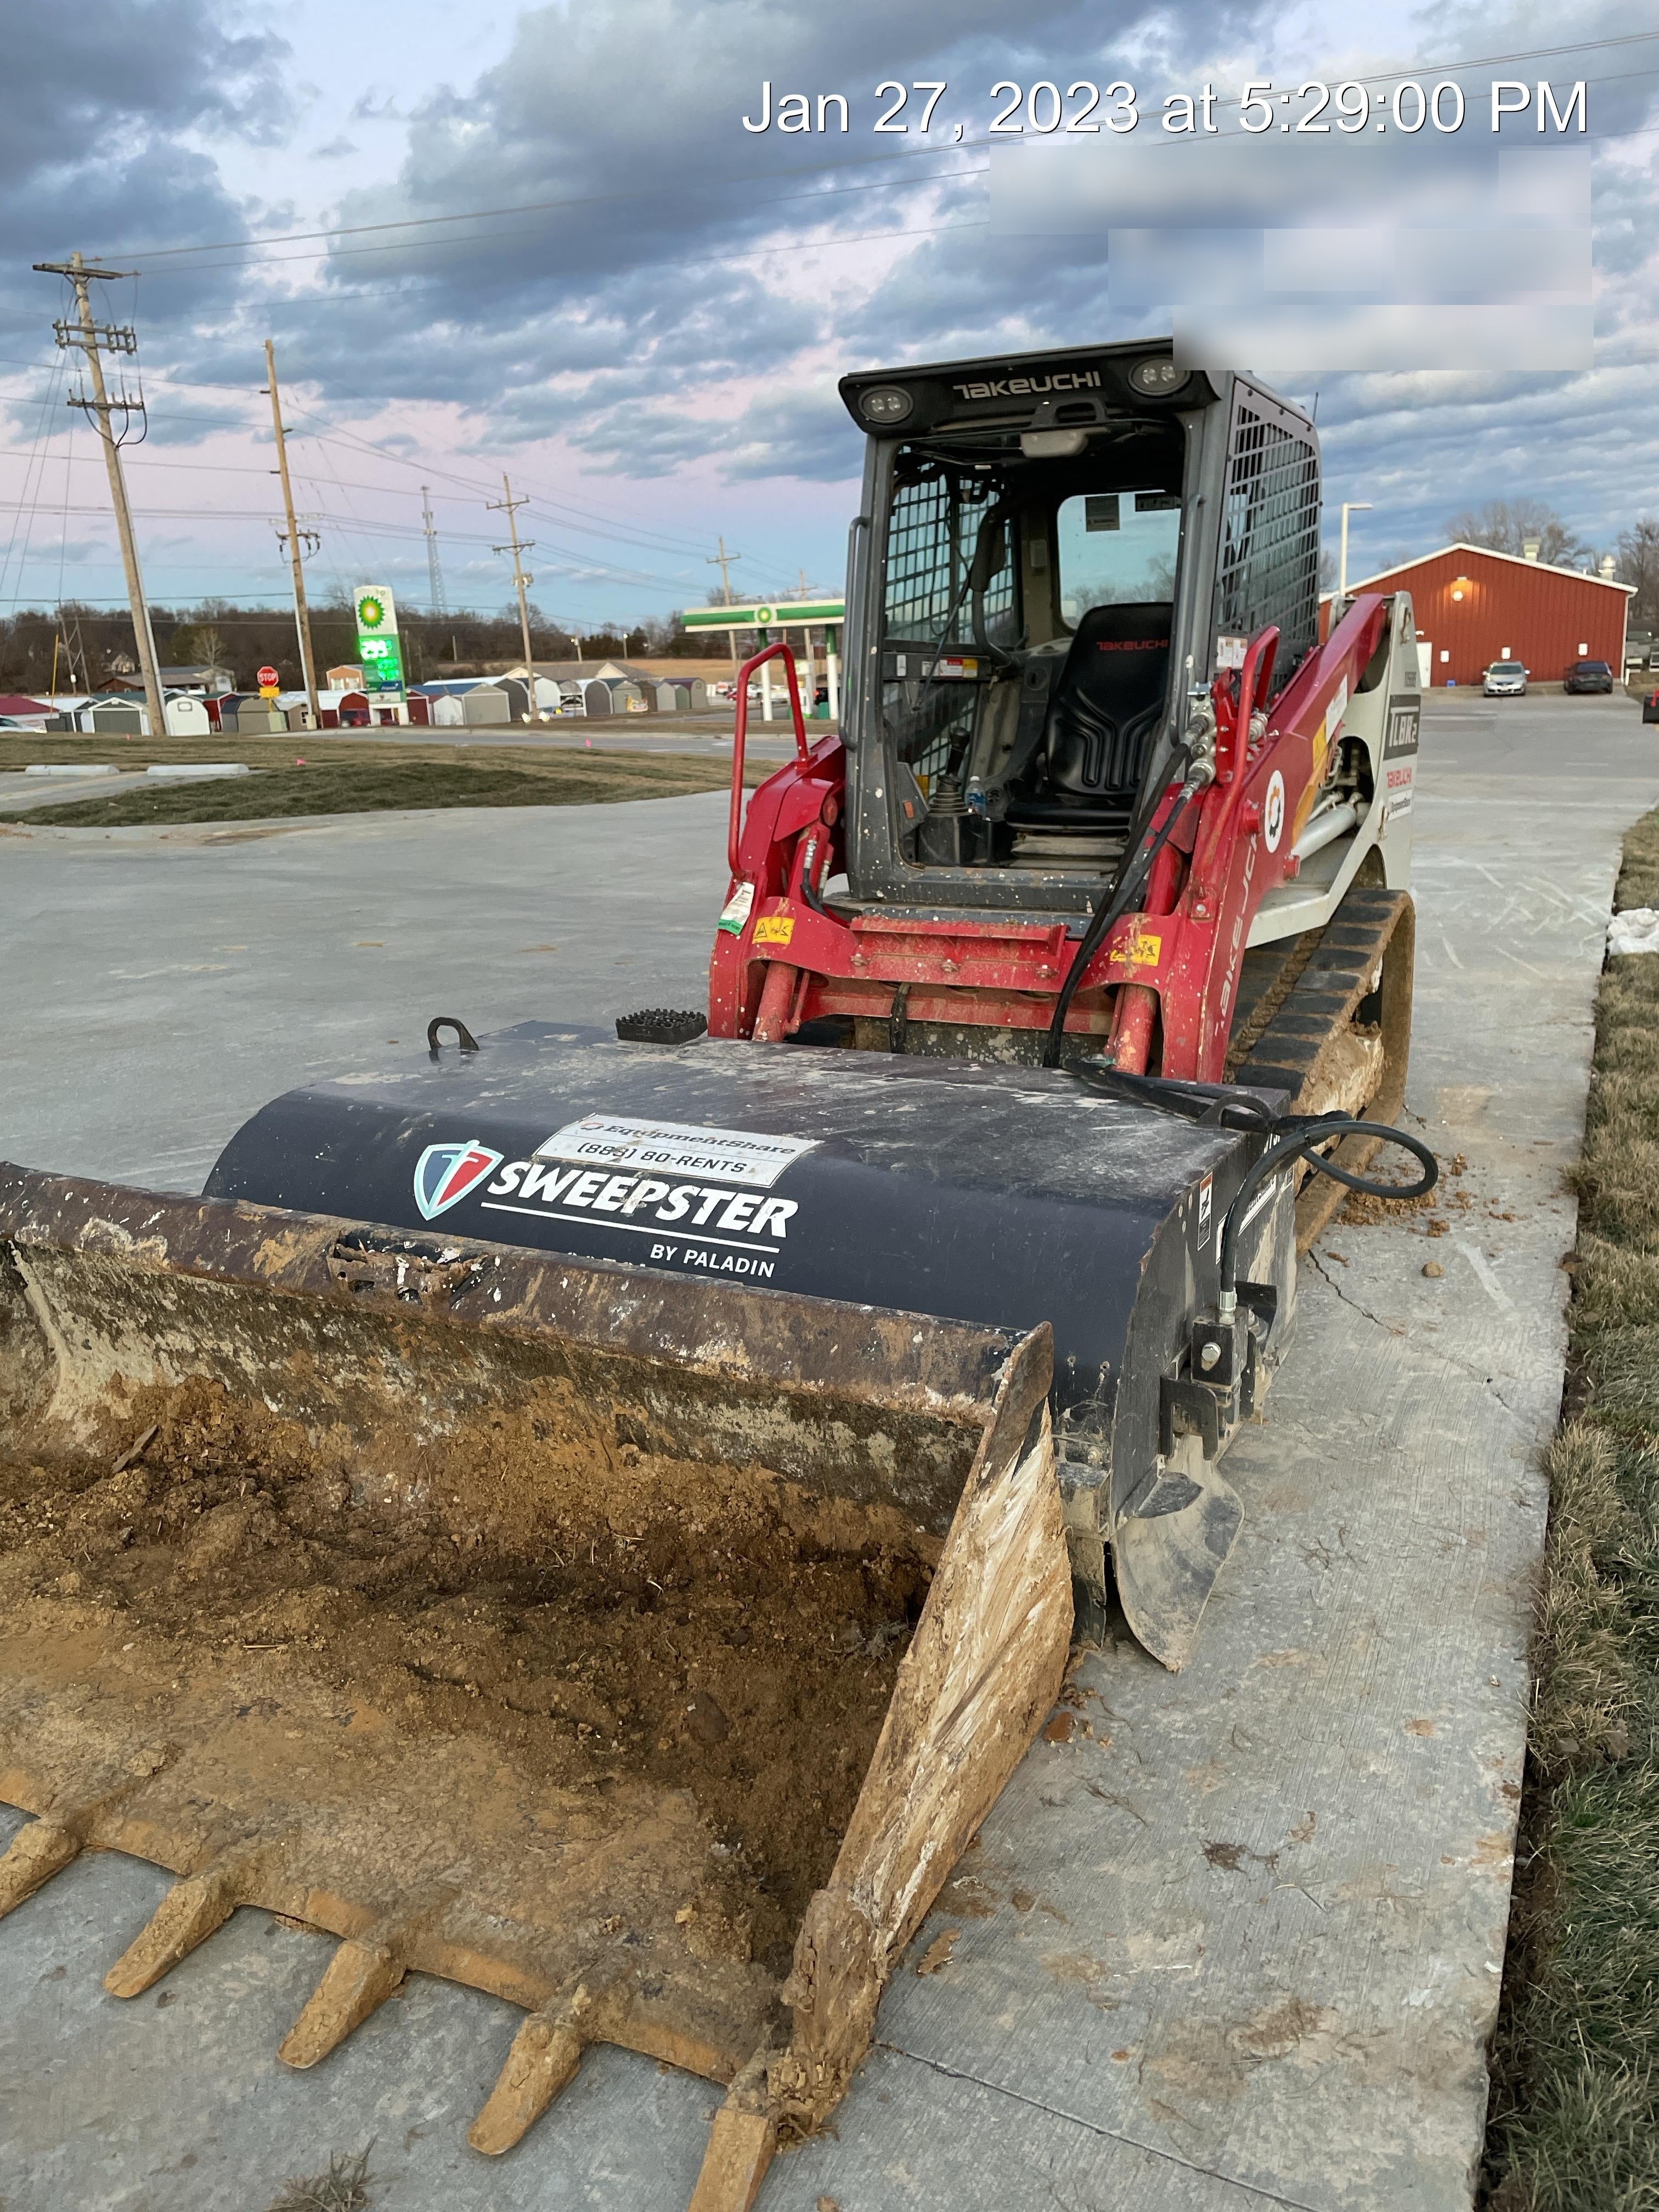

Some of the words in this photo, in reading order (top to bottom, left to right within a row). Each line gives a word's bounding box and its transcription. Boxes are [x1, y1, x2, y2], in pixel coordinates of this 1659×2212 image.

[259, 673, 276, 682] STOP
[603, 1125, 796, 1155] EquipmentShare
[640, 1150, 748, 1172] 80-RENTS
[487, 1160, 799, 1239] SWEEPSTER
[650, 1243, 678, 1263] BY
[682, 1246, 776, 1278] PALADIN
